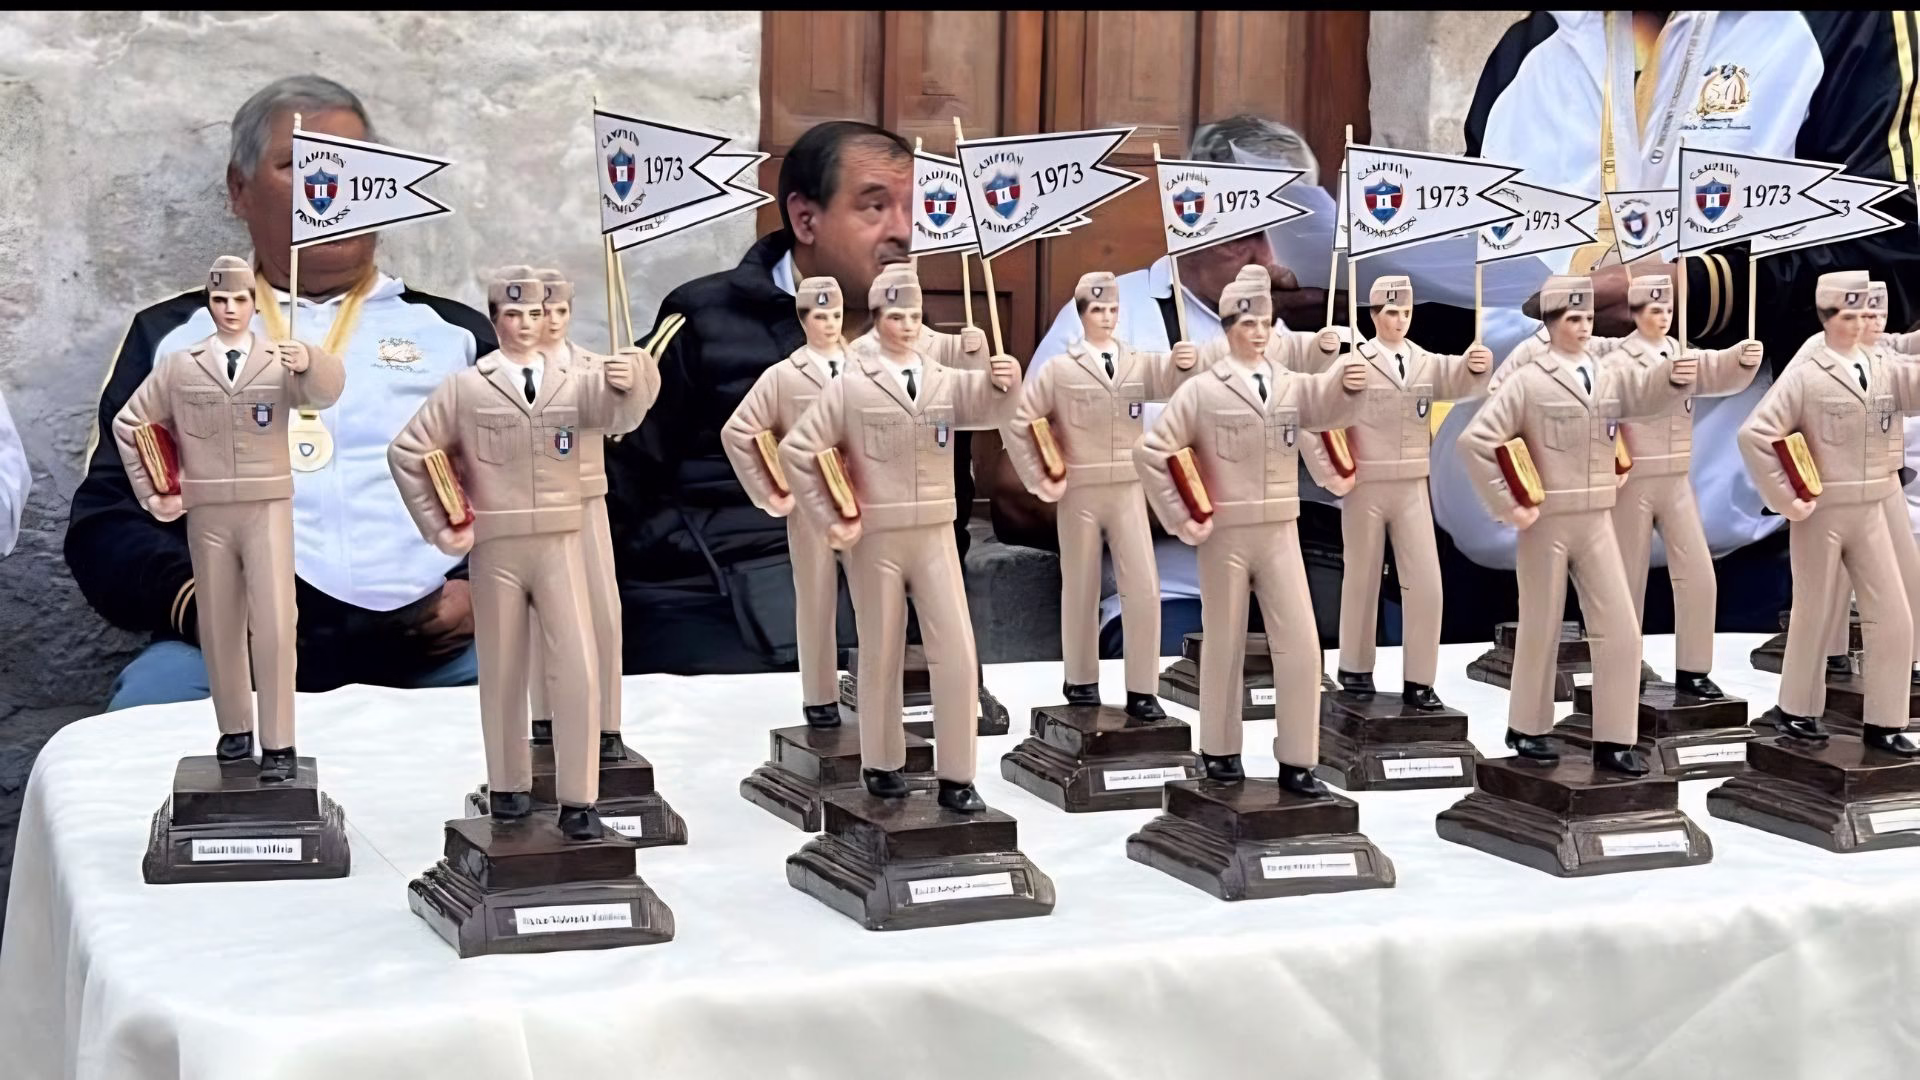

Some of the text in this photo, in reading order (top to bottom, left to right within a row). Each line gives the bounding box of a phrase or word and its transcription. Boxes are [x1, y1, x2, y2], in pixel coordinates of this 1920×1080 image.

[644, 156, 684, 184] 1973
[1032, 162, 1084, 197] 1973
[350, 176, 397, 201] 1973
[1417, 186, 1470, 210] 1973
[1744, 185, 1791, 208] 1973
[1214, 190, 1260, 213] 1973
[1524, 210, 1560, 231] 1973
